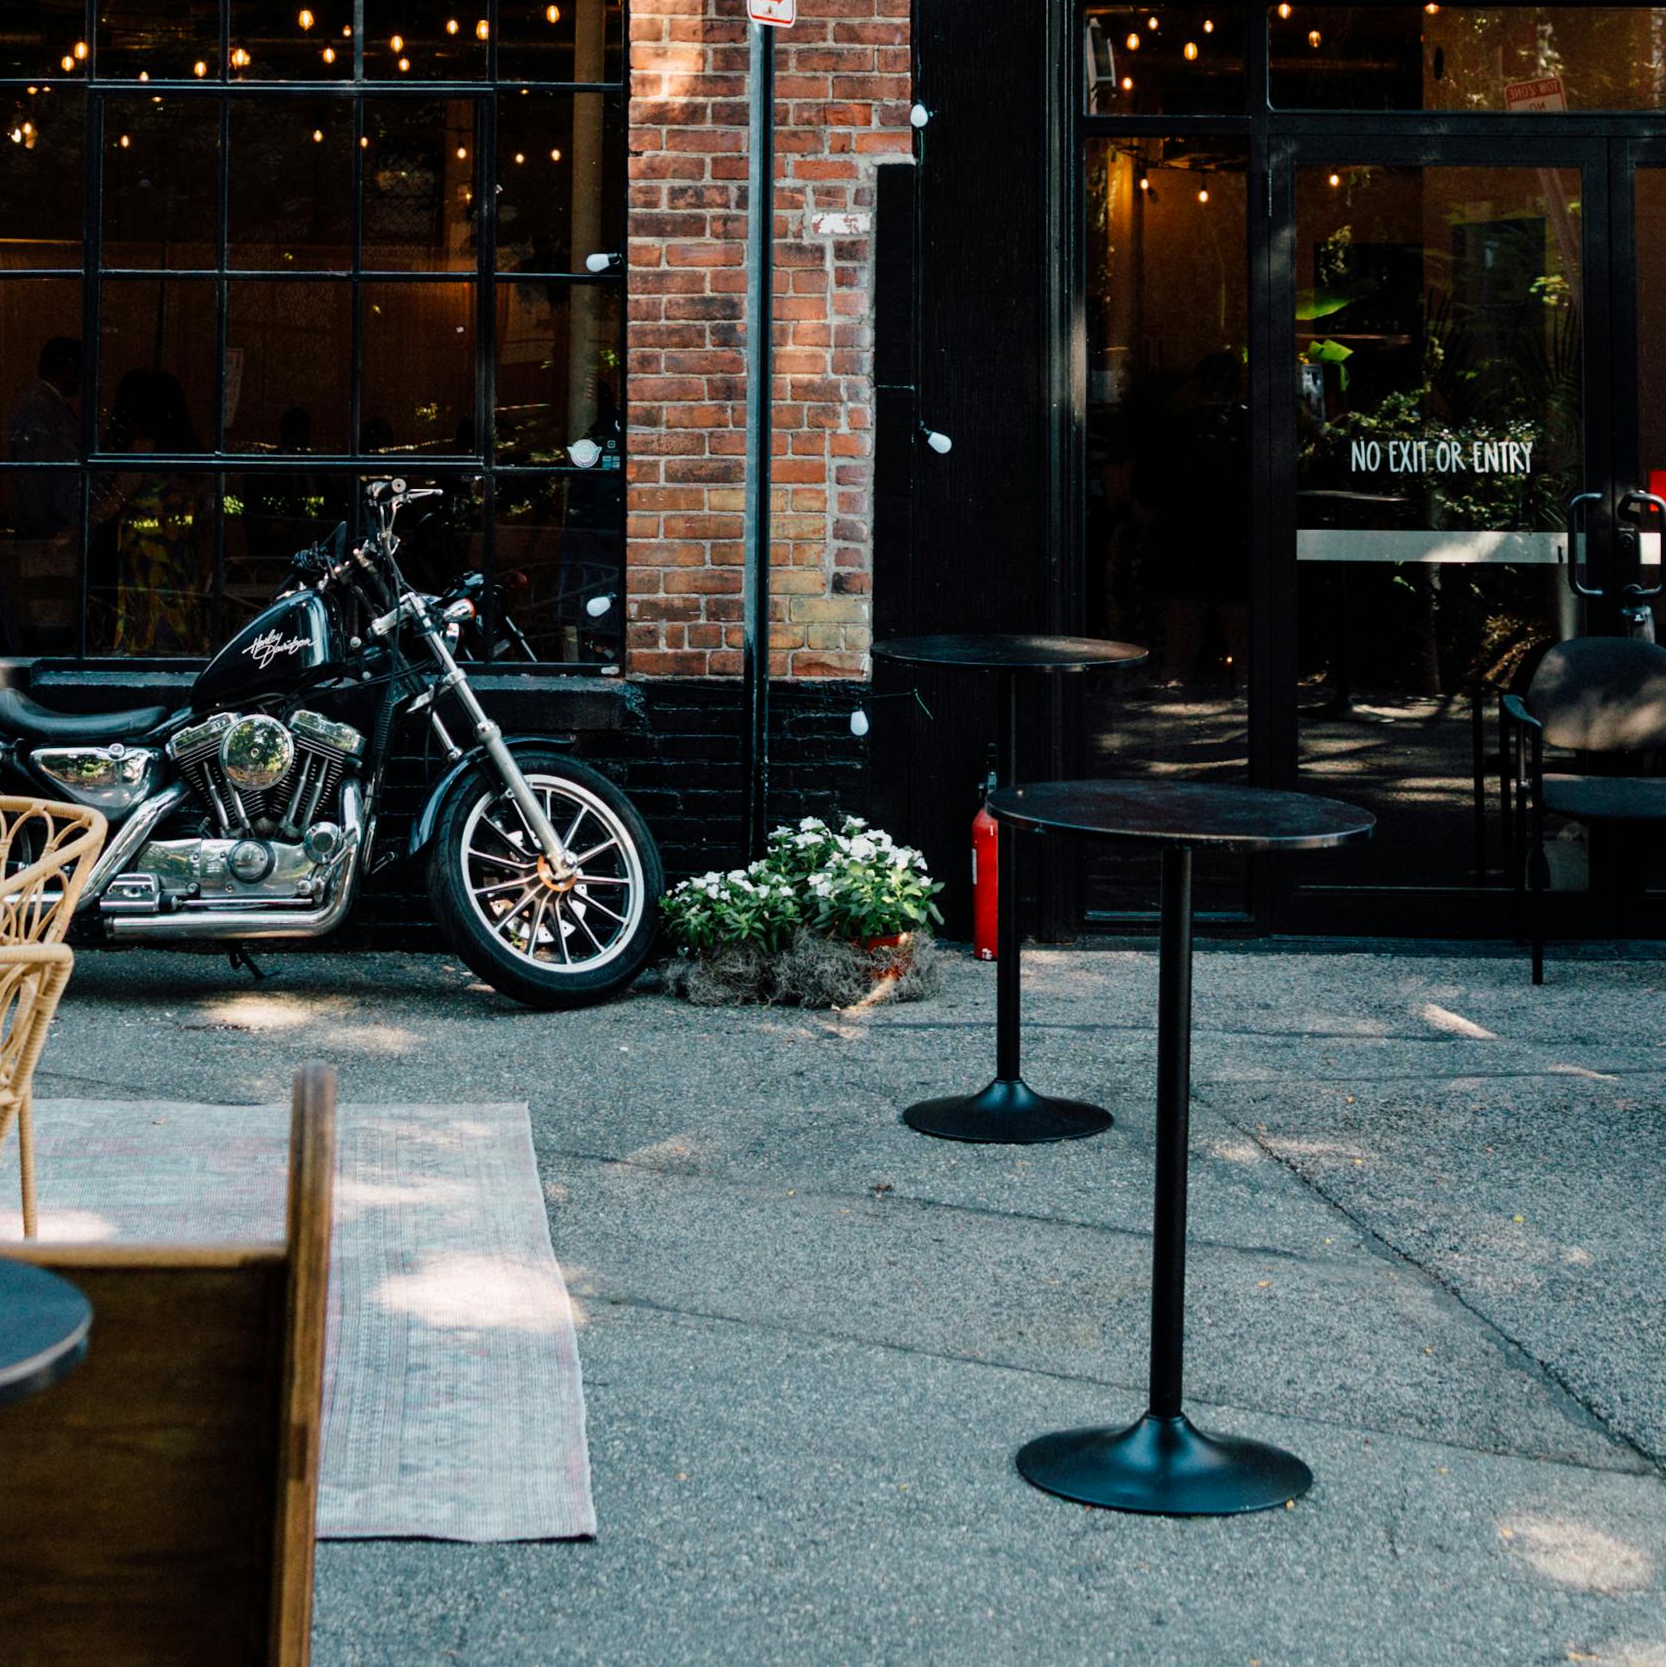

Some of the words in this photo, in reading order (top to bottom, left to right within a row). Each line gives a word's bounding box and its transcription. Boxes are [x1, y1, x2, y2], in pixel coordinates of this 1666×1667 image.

[1351, 440, 1381, 472] NO
[1389, 440, 1428, 473] EXIT
[1436, 441, 1466, 473] OR
[1473, 441, 1533, 473] ENTRY
[241, 629, 283, 654] Harley
[253, 636, 320, 669] Davidson
